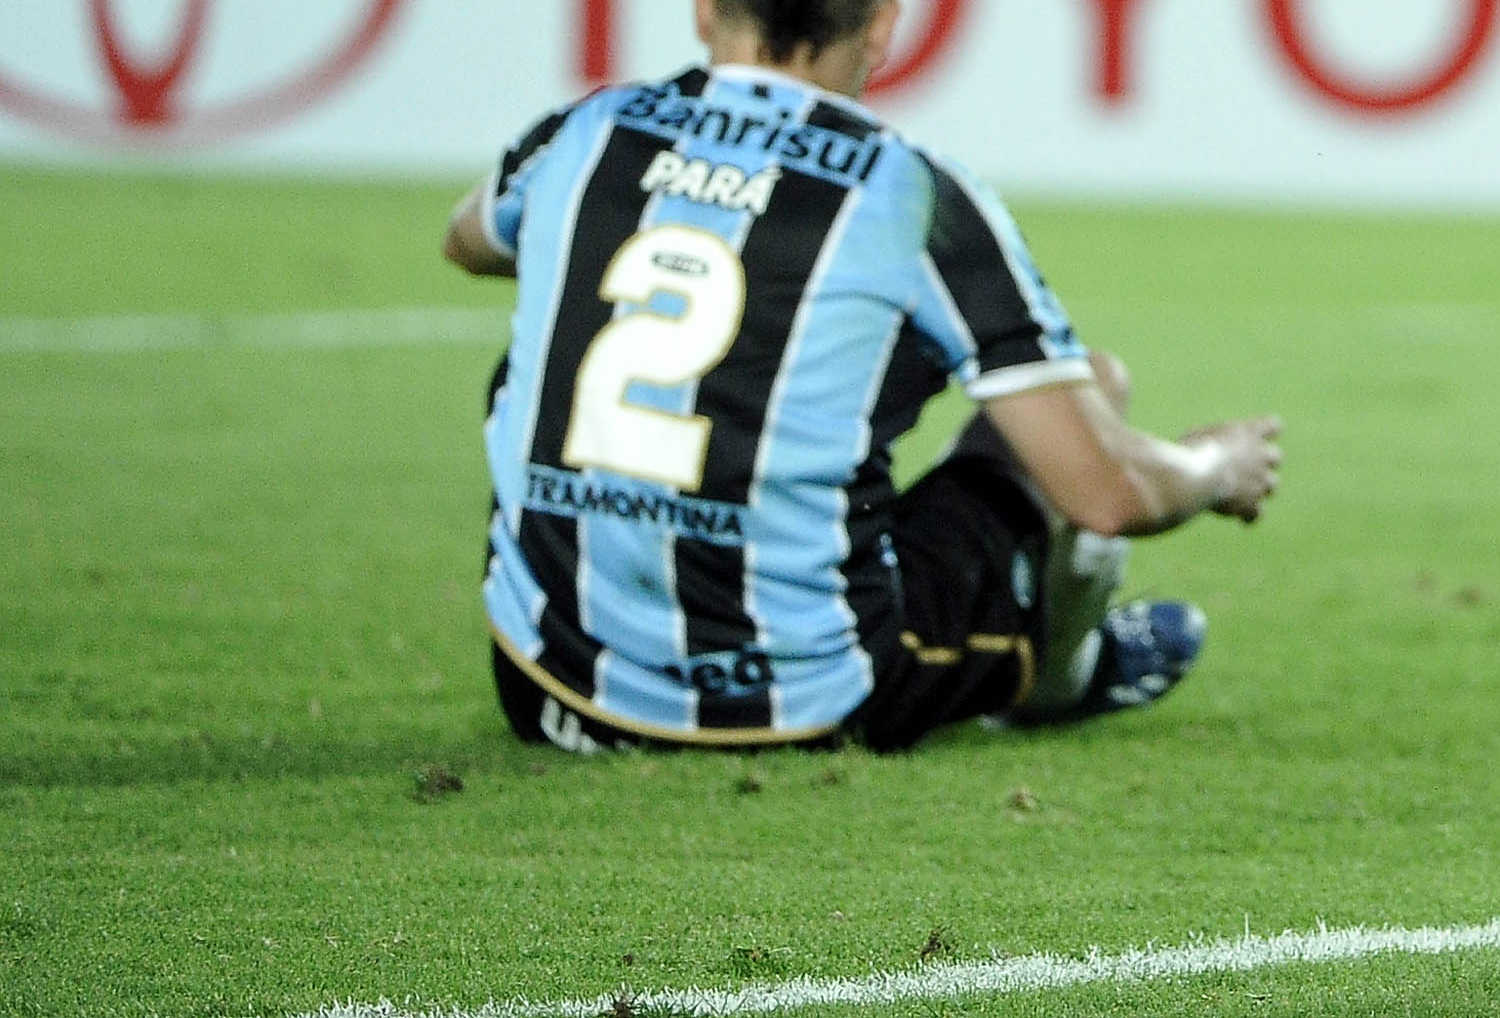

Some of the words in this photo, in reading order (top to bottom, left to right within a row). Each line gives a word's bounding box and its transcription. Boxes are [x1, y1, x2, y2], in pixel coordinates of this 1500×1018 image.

[615, 82, 884, 184] Banrisul
[640, 149, 783, 216] PARÁ
[560, 222, 748, 495] 2
